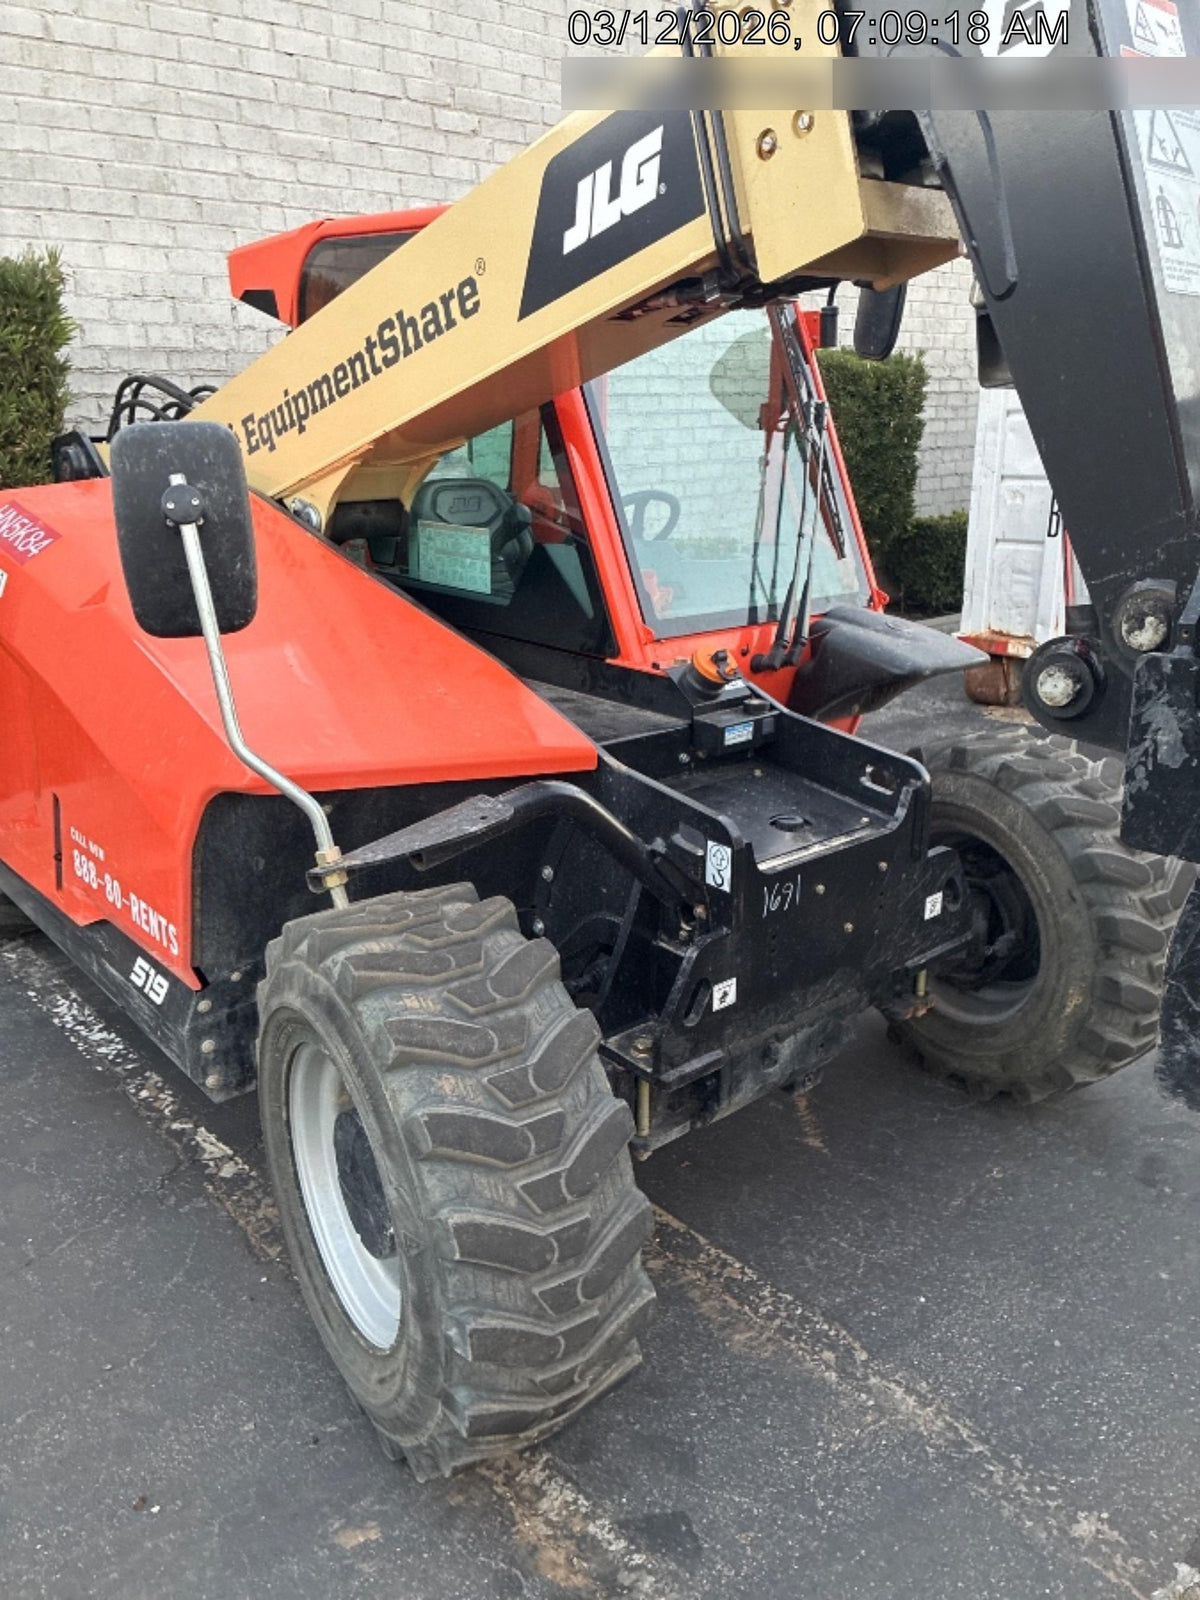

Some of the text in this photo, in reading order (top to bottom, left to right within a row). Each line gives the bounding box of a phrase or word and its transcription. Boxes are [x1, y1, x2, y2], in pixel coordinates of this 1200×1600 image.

[563, 124, 664, 255] JLG
[241, 275, 481, 456] EquipmentShare
[73, 849, 179, 956] 888-80-RENTS
[762, 874, 801, 919] 1691
[129, 956, 169, 1006] 519
